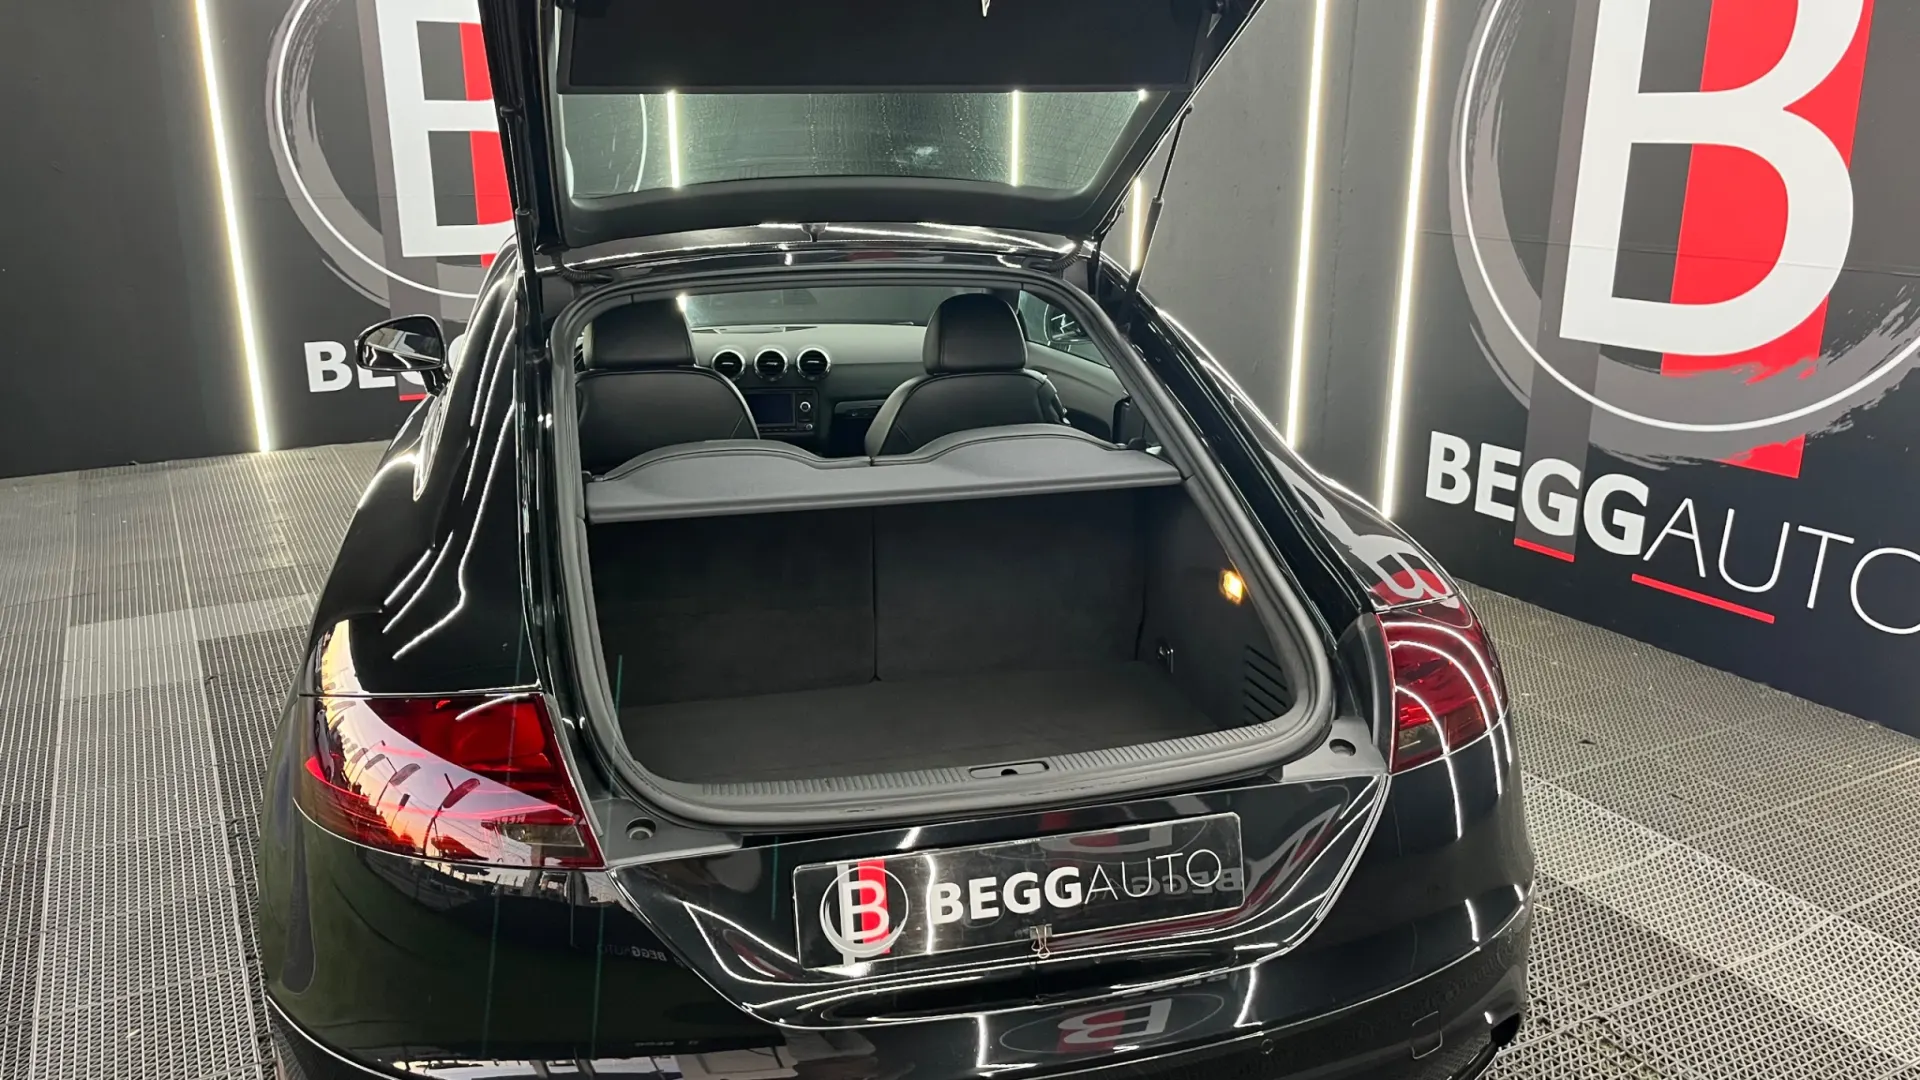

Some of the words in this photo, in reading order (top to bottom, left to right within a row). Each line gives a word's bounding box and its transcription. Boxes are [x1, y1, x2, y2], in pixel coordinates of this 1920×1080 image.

[1559, 0, 1864, 357] B
[841, 879, 890, 942] B
[929, 849, 1222, 925] BEGGAUTO
